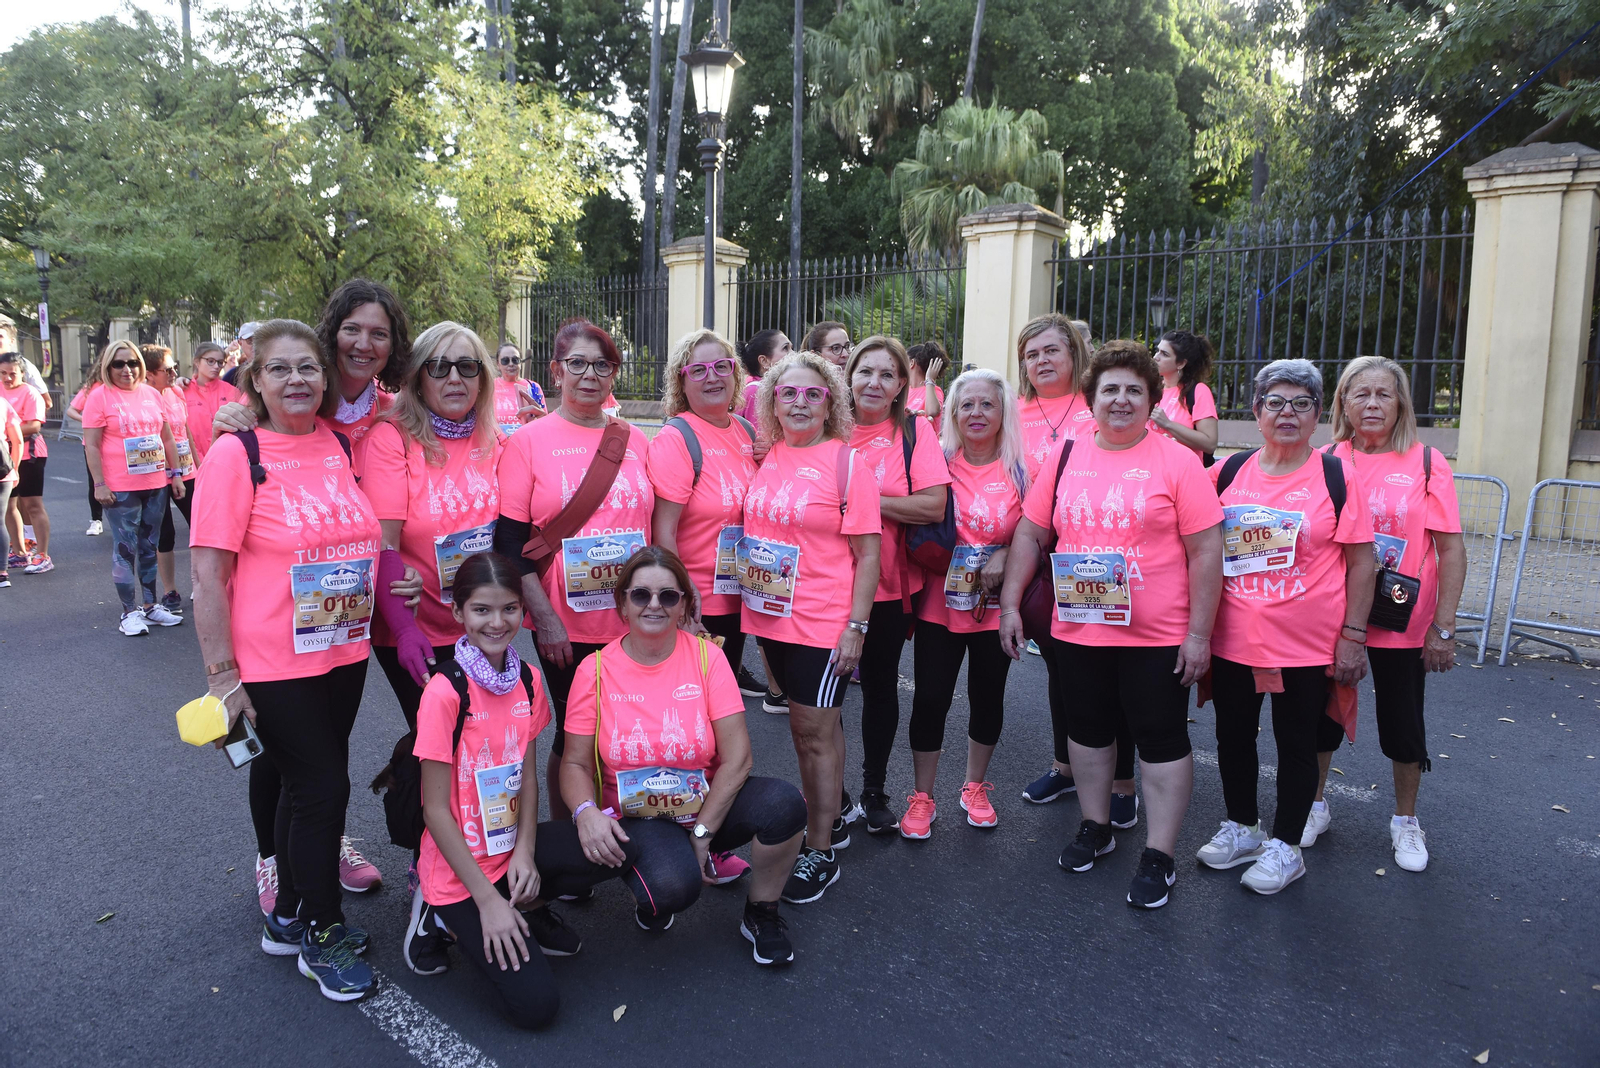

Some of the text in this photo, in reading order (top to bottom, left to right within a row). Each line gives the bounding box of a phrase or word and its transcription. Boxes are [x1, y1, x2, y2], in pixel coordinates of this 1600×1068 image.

[1023, 418, 1051, 429] OYSHO
[140, 450, 157, 458] 016
[552, 447, 587, 457] OYSHO
[262, 460, 300, 471] OYSHO
[1231, 487, 1260, 500] OYSHO
[1242, 526, 1272, 543] 016
[295, 540, 378, 563] TU DORSAL
[1081, 545, 1144, 557] DORSAL
[1251, 543, 1265, 551] 3237
[590, 549, 624, 558] ASTURIANA
[591, 563, 624, 579] 016
[747, 565, 773, 583] 016
[1075, 565, 1106, 573] ASTURIANA
[584, 589, 605, 597] CARRERA
[1076, 581, 1107, 594] 016
[1225, 576, 1307, 599] SUMA
[324, 594, 358, 612] 016
[575, 599, 601, 608] OYSHO
[1063, 611, 1087, 619] OYSHO
[314, 624, 338, 632] CARRERA
[303, 636, 334, 647] OYSHO
[609, 693, 645, 703] OYSHO
[647, 793, 684, 808] 016
[461, 805, 481, 818] TU
[495, 838, 515, 848] OYSH
